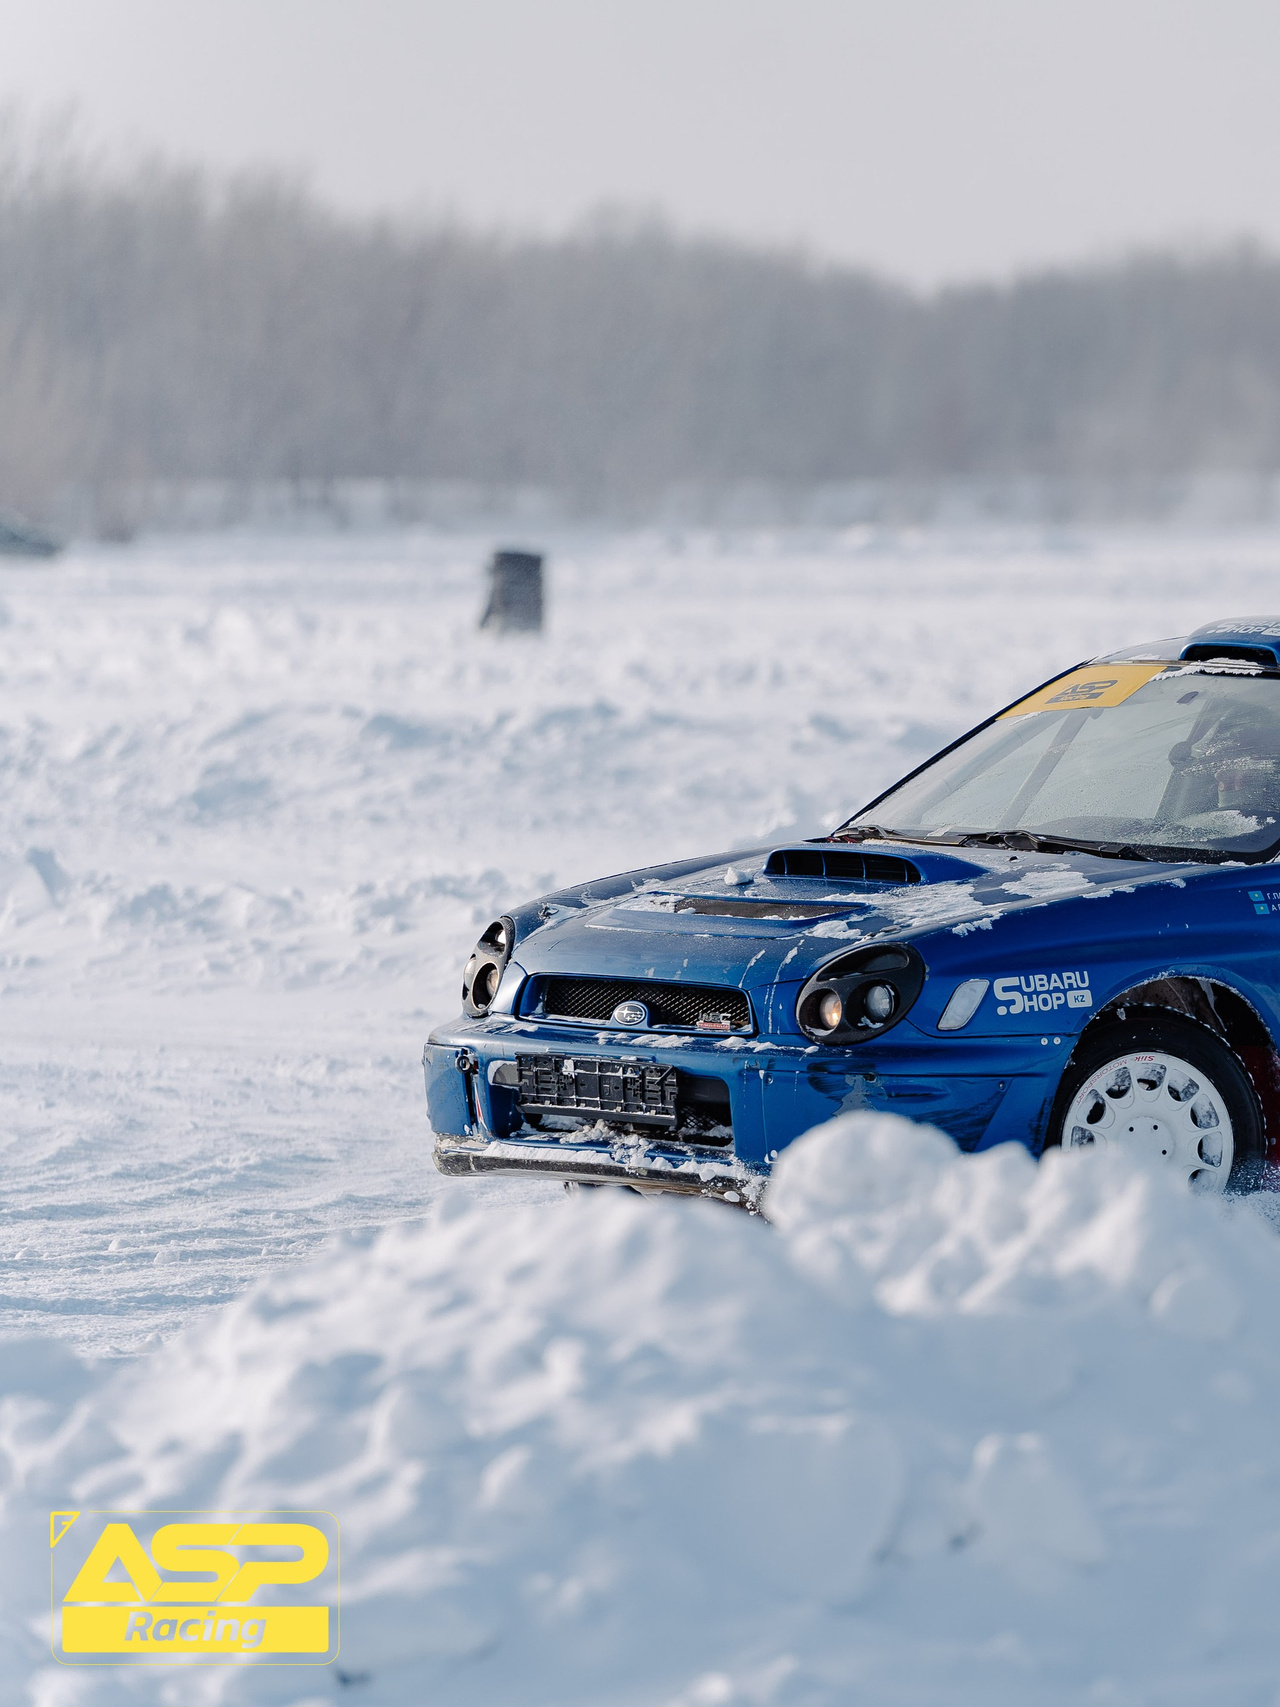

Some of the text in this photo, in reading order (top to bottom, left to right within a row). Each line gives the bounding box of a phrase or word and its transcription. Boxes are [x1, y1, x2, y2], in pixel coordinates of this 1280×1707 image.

[1057, 680, 1118, 695] ASP
[994, 970, 1089, 1014] SUBARU
[1073, 994, 1086, 1003] KZ
[1076, 1059, 1127, 1106] MOTORSPORT
